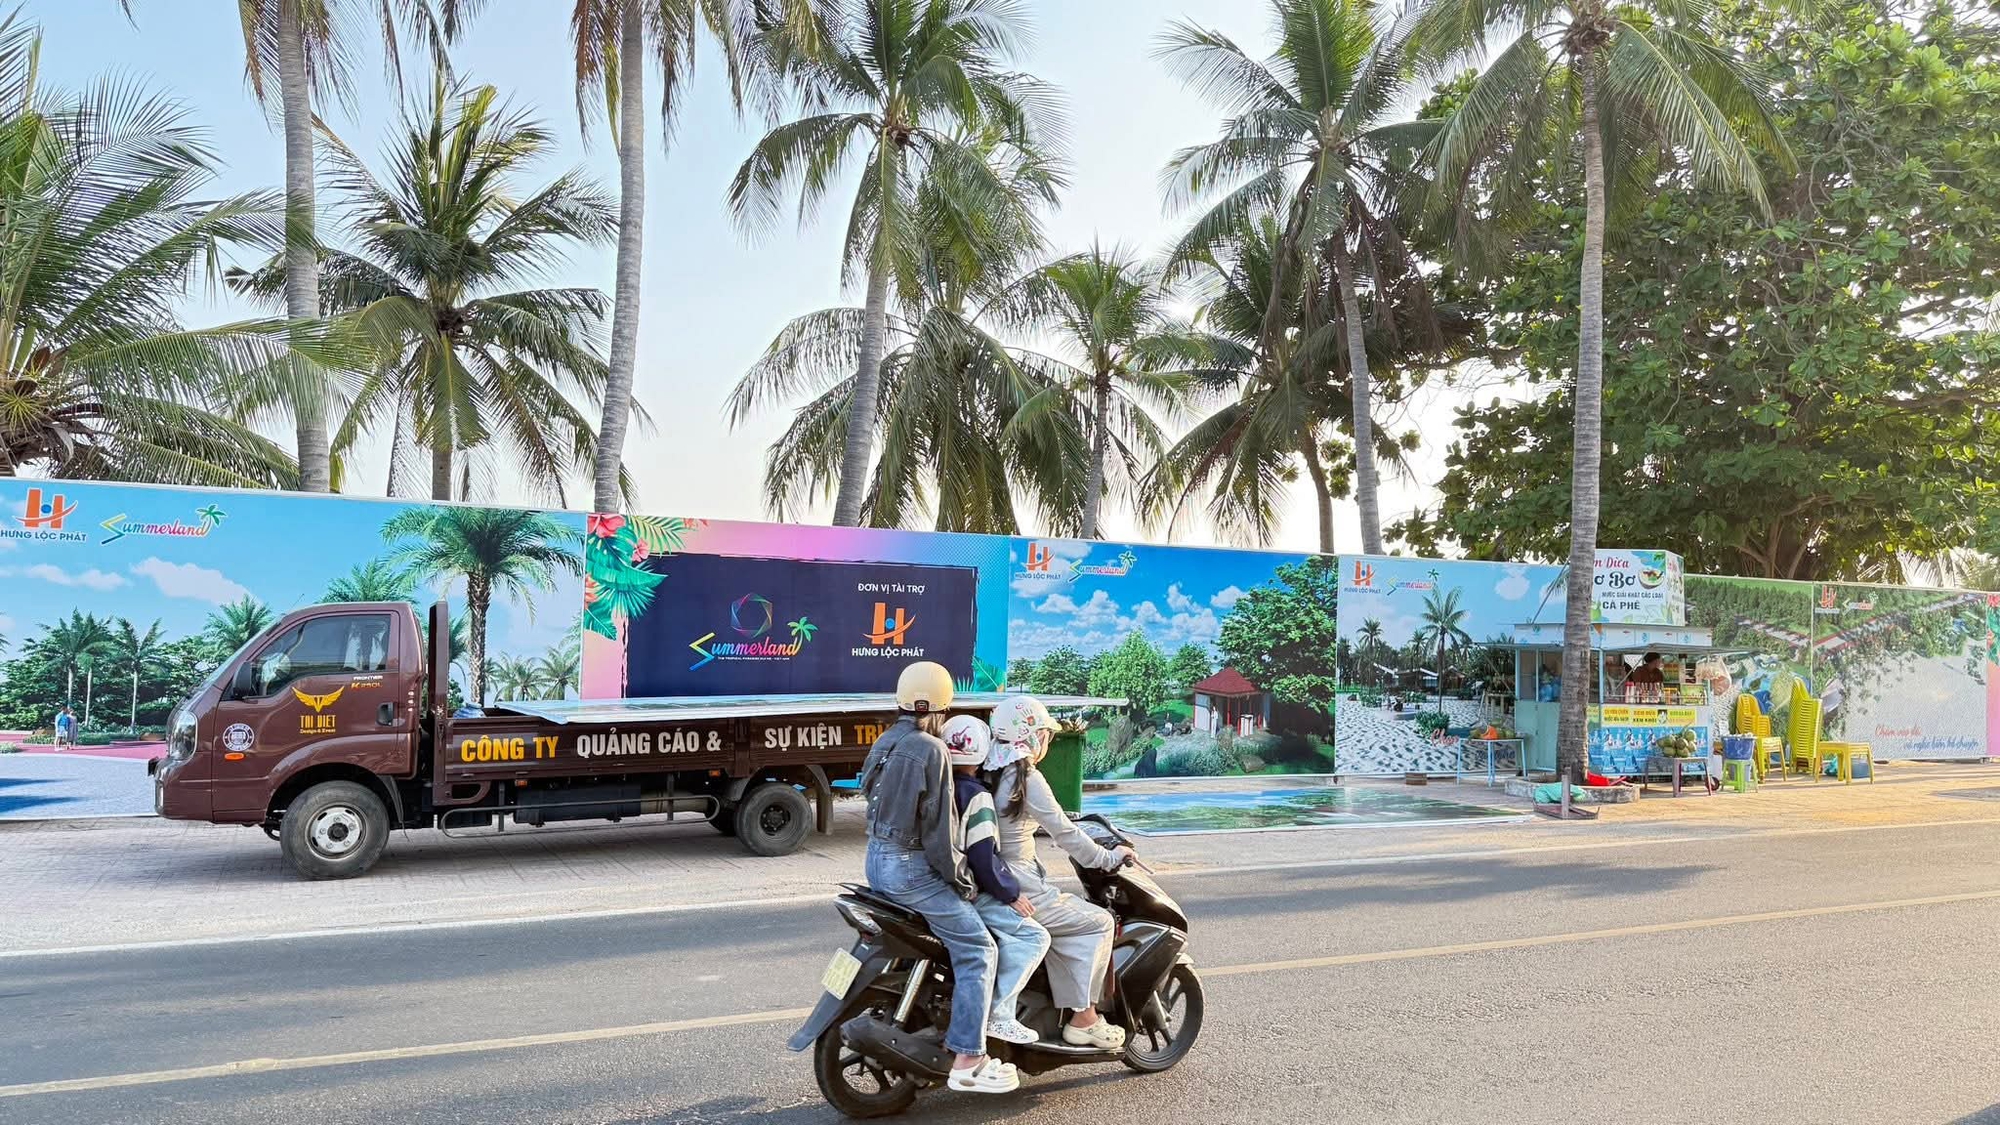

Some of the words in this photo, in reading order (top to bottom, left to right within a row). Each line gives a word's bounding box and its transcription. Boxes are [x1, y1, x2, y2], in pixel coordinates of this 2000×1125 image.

[1, 531, 32, 539] HƯNG
[35, 530, 57, 542] LỘC
[60, 532, 87, 542] PHÁT
[100, 511, 211, 545] Summerland
[1033, 572, 1045, 580] LỘC
[1069, 560, 1127, 582] Summerland
[858, 583, 879, 592] ĐƠN
[881, 584, 890, 595] VỊ
[892, 583, 905, 592] TÀI
[907, 585, 925, 595] TRỢ
[689, 632, 801, 671] Summerland
[851, 647, 879, 656] HƯNG
[881, 646, 900, 658] LỘC
[901, 646, 925, 657] PHÁT
[461, 734, 525, 762] CÔNG
[533, 735, 559, 759] TY
[576, 727, 651, 759] QUẢNG
[657, 727, 700, 753] CÁO
[706, 730, 722, 751] &
[764, 725, 792, 752] SỰ
[797, 722, 842, 750] KIỆN
